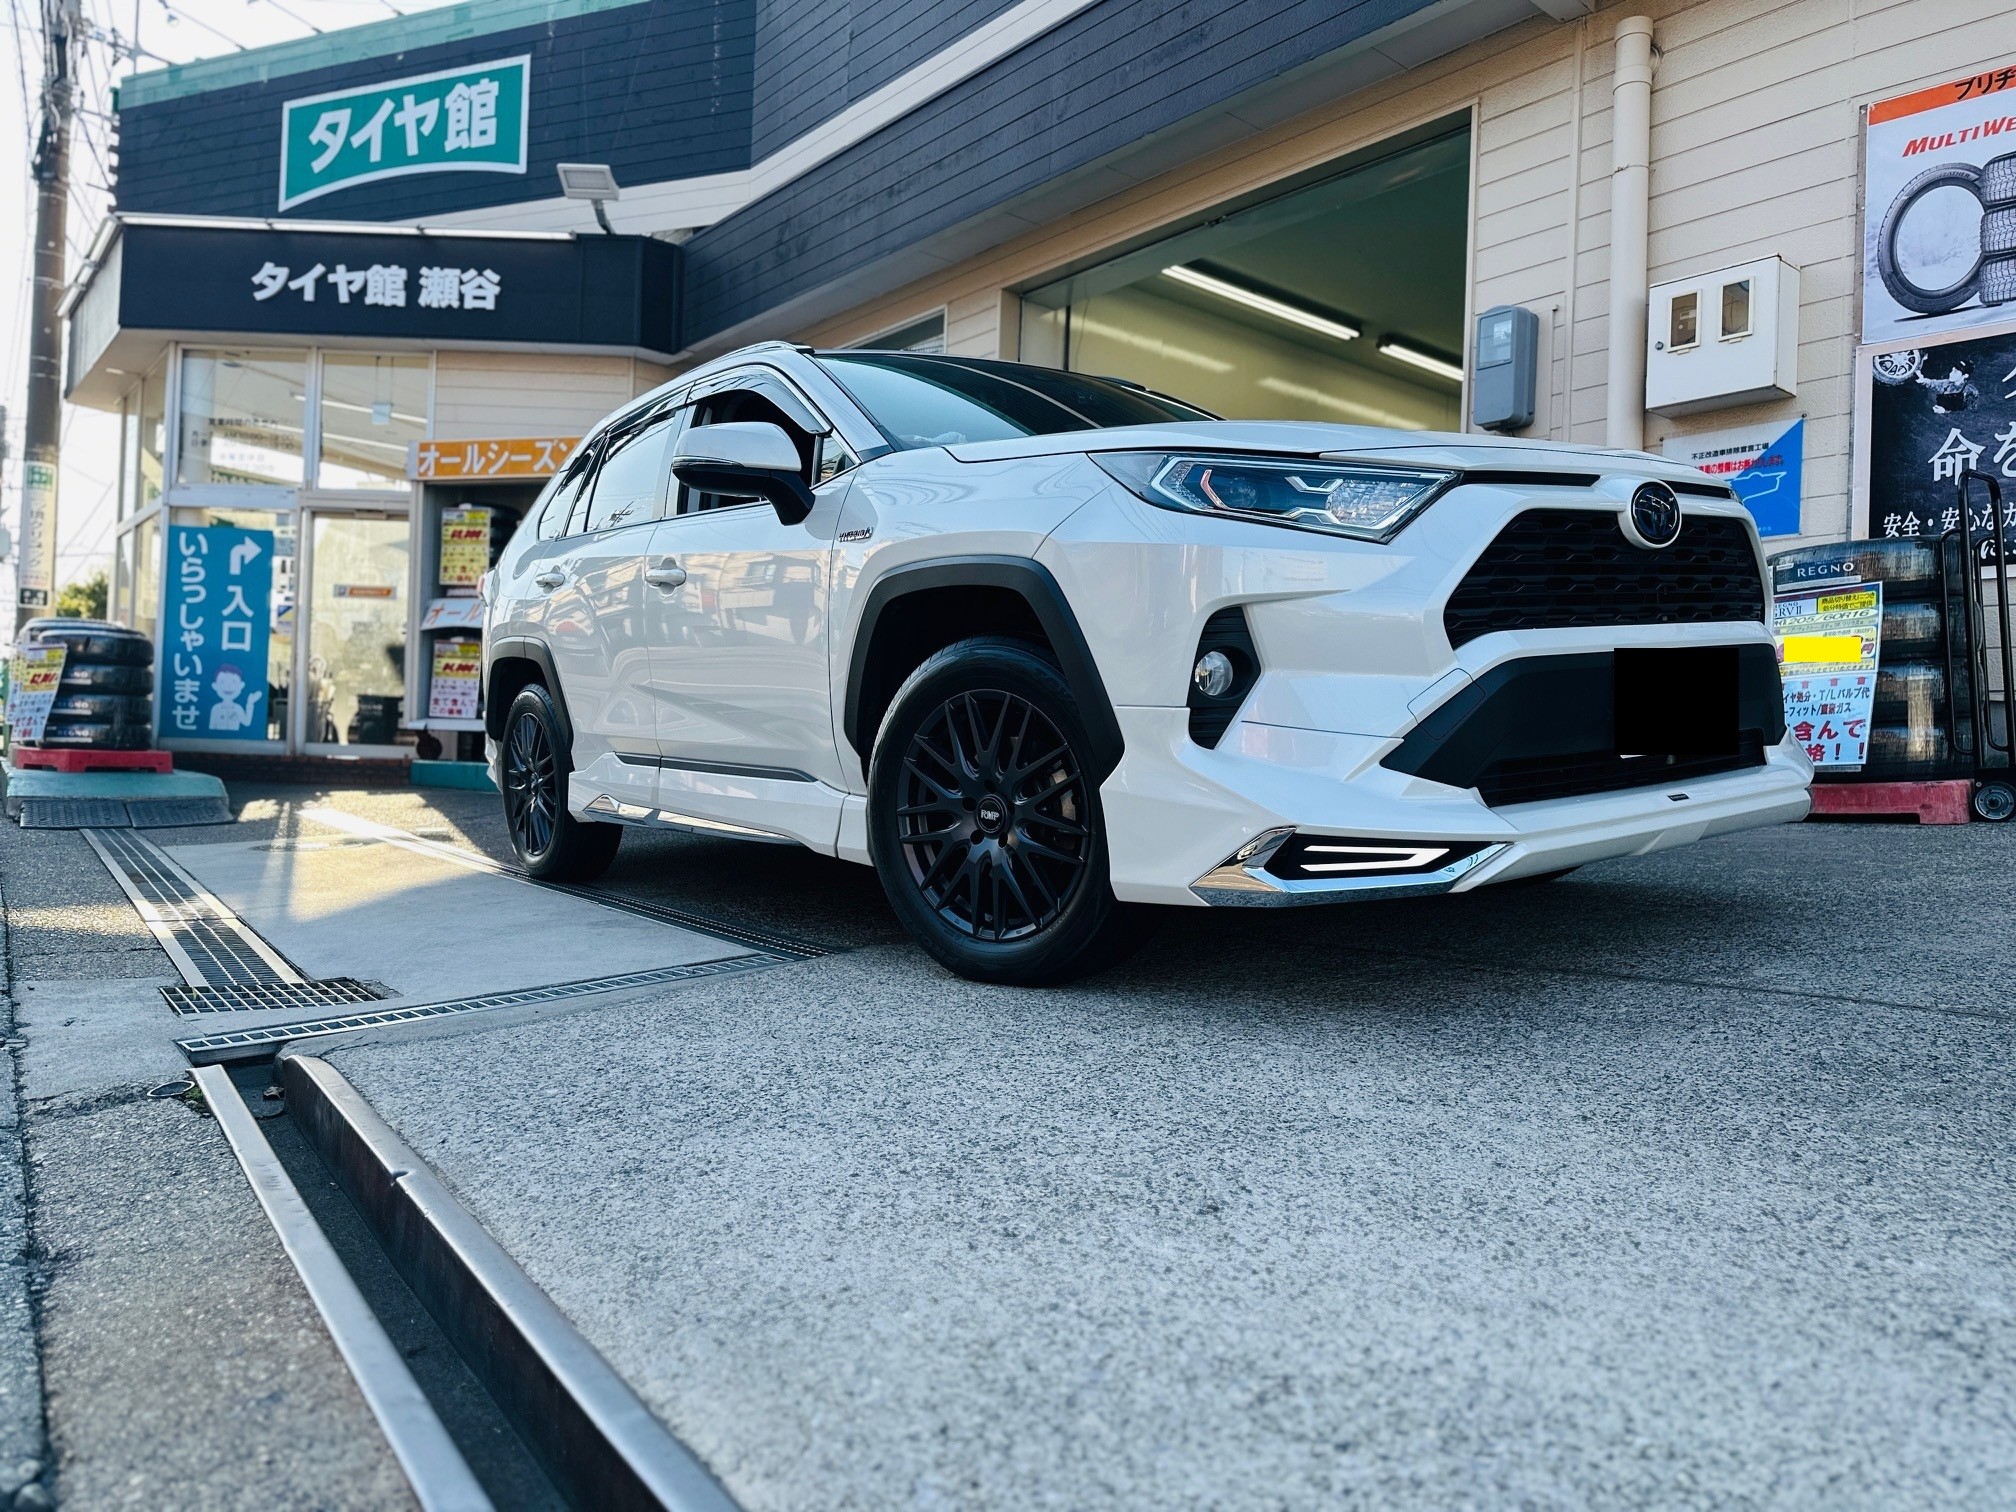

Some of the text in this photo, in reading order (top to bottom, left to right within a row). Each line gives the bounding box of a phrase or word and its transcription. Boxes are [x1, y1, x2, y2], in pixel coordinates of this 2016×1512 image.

[308, 78, 499, 174] タイヤ館
[251, 261, 501, 310] タイヤ館 瀬谷
[1797, 562, 1854, 578] REGNO
[172, 531, 208, 730] いらっしゃいませ
[221, 585, 254, 652] 入口
[1788, 610, 1869, 625] 205/60R16
[1793, 719, 1866, 741] 含んで
